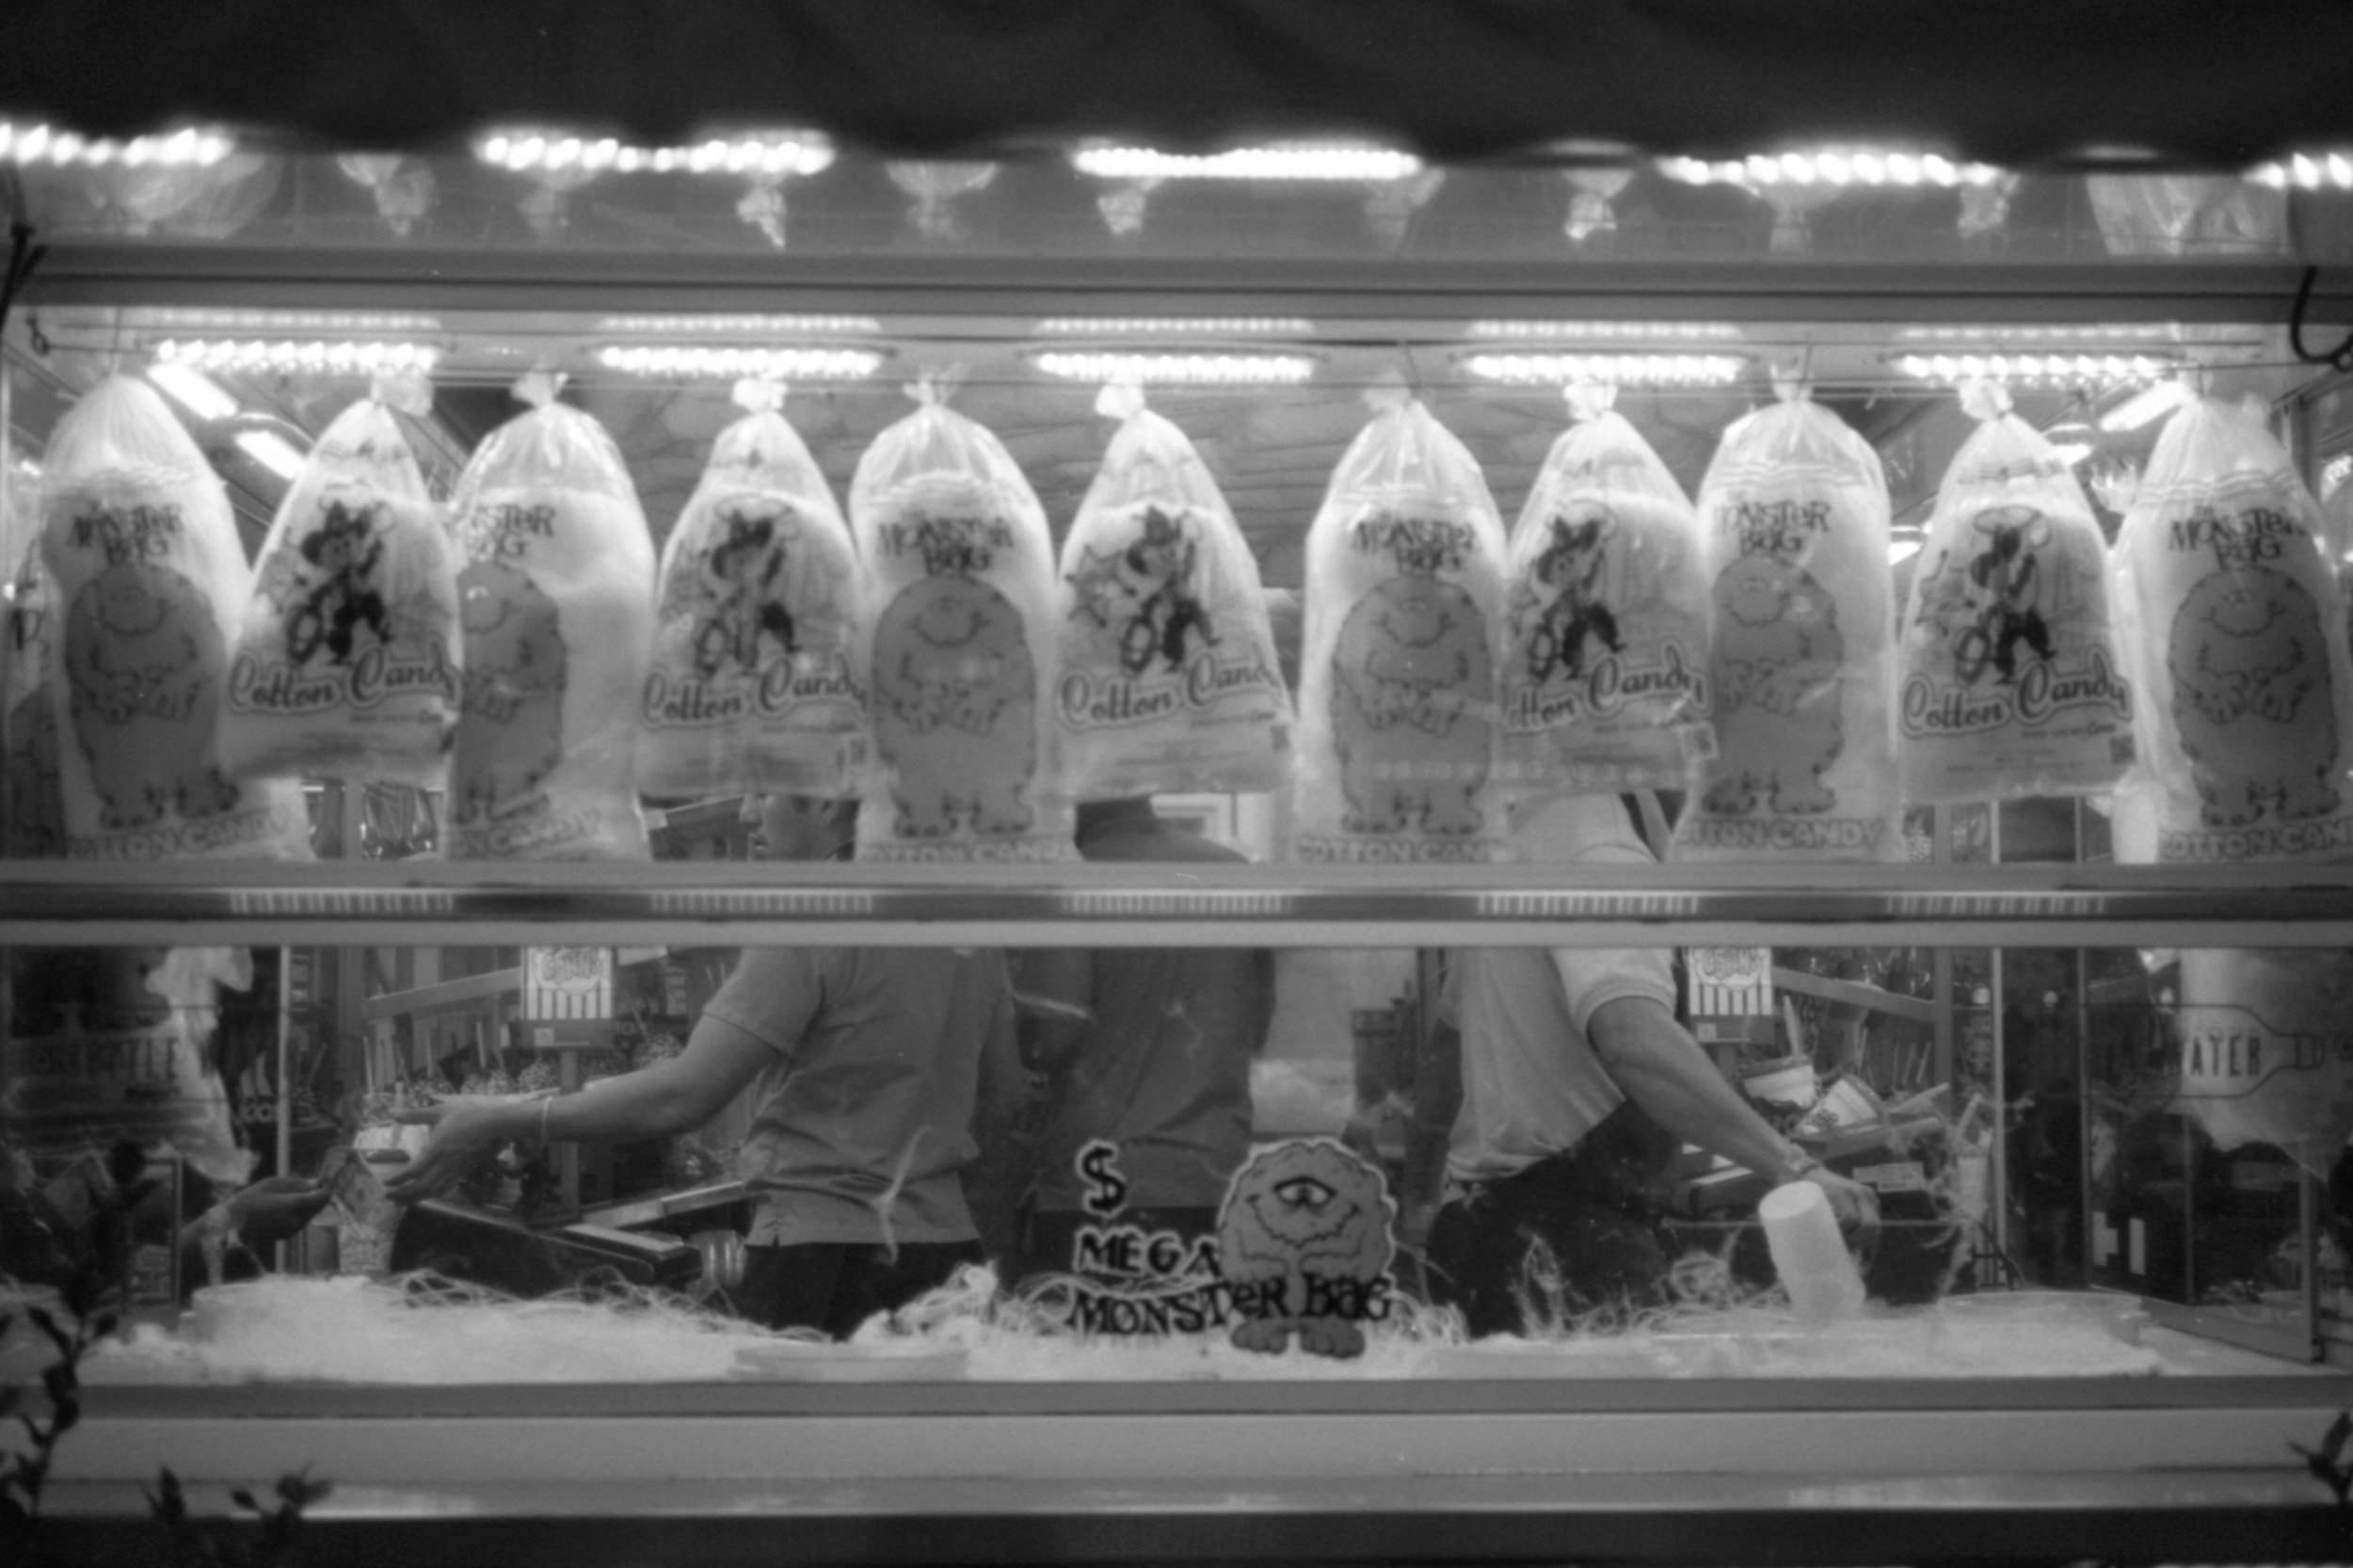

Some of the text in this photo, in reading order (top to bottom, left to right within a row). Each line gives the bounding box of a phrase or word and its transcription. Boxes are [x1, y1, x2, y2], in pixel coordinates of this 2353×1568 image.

[231, 654, 337, 707] Cotton
[643, 669, 743, 723] Cotton
[1060, 671, 1175, 725] Cotton
[1904, 651, 2127, 730] Cotton Candy
[2277, 817, 2353, 855] CAN
[1080, 1227, 1223, 1275] MEGA
